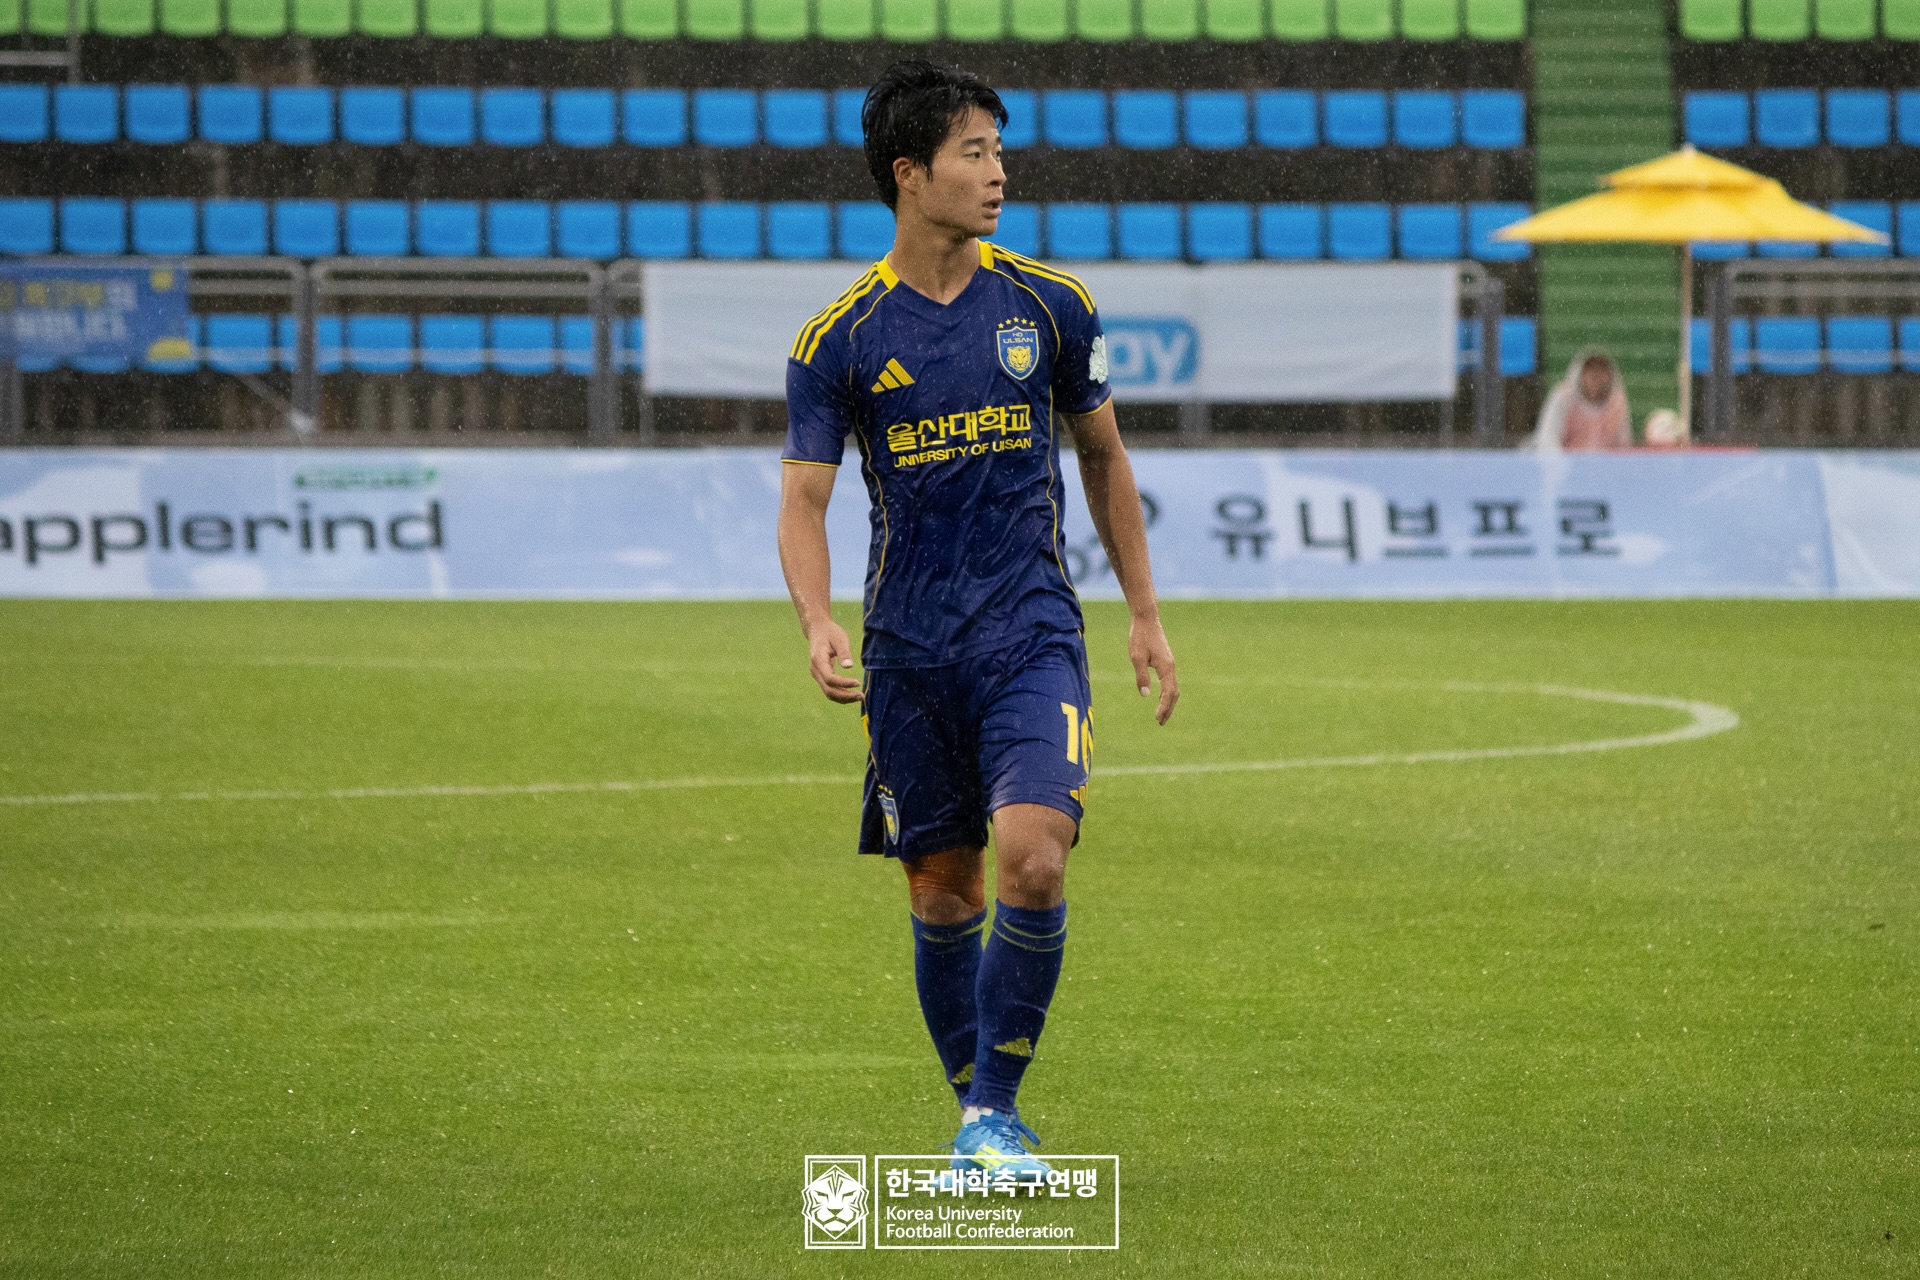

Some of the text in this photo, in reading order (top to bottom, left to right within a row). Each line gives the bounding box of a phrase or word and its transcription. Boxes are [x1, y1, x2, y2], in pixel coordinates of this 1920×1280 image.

[887, 404, 1031, 453] 울산대학교
[894, 446, 969, 468] UNIVERSITY
[970, 442, 990, 456] OF
[1209, 494, 1621, 562] 유니브프로
